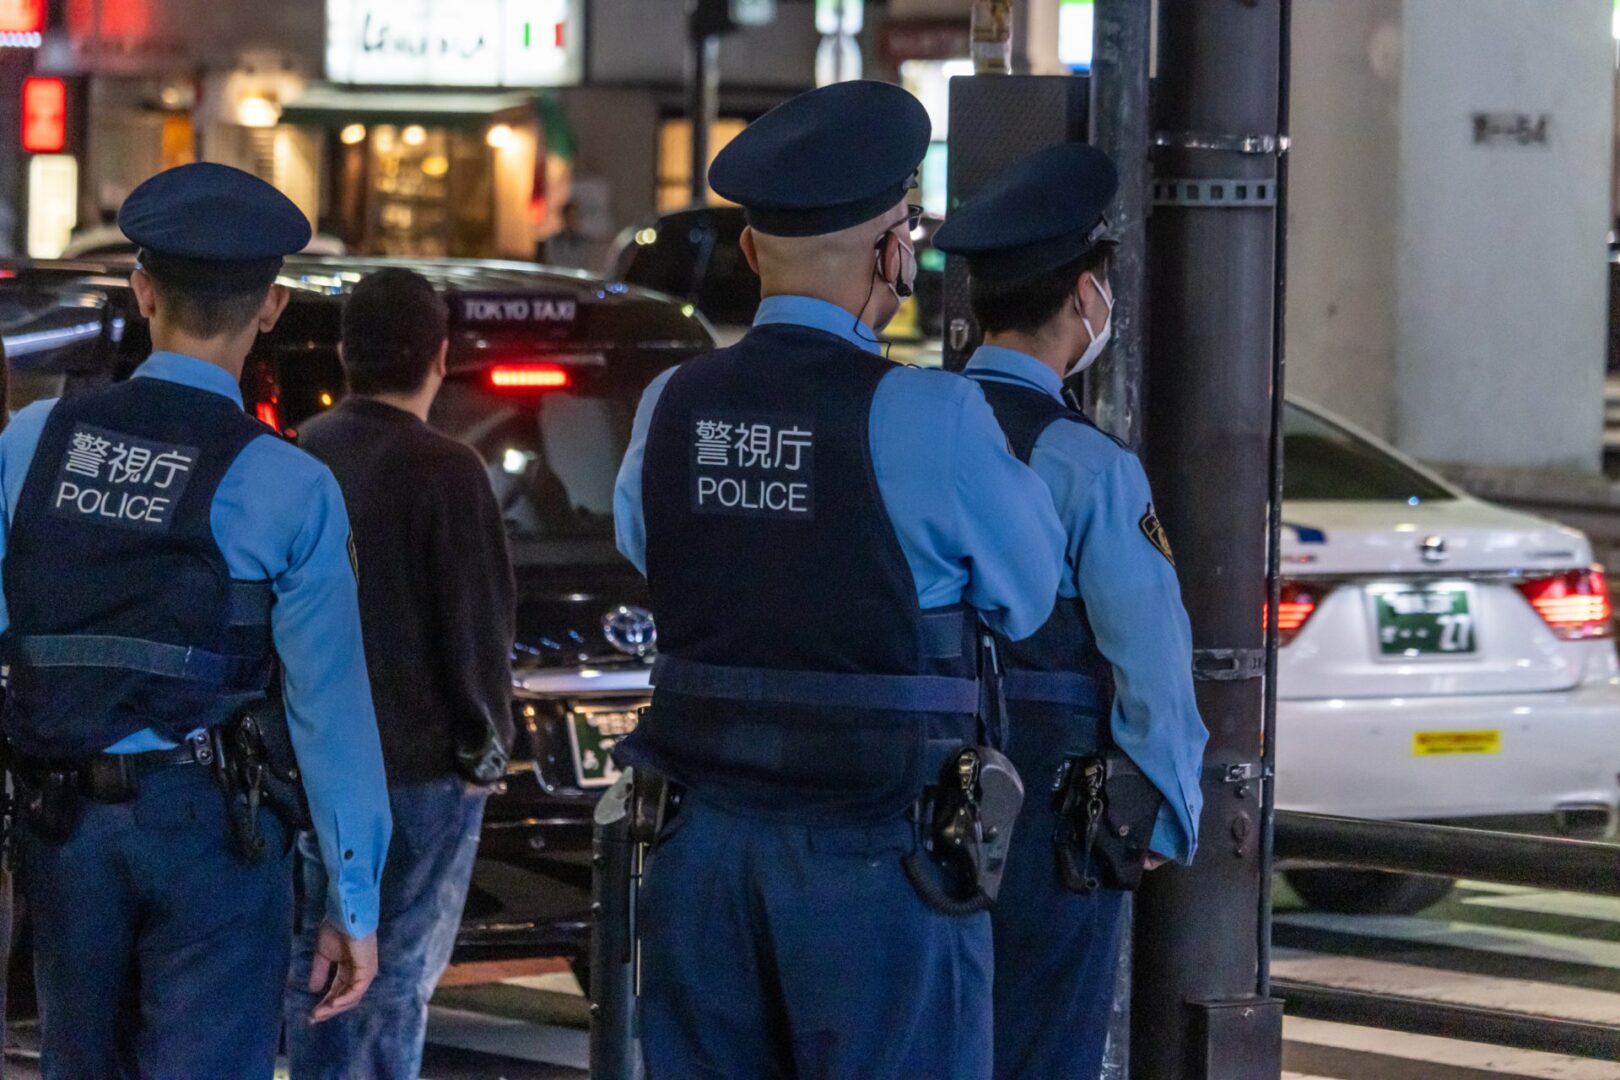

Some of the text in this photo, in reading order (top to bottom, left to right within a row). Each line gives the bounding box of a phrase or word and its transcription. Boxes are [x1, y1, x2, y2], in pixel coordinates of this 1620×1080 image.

[465, 300, 576, 320] TOKYO TAXI
[65, 432, 192, 488] 警視庁
[694, 420, 813, 470] 警視庁
[56, 482, 170, 522] POLICE
[698, 477, 808, 512] POLICE
